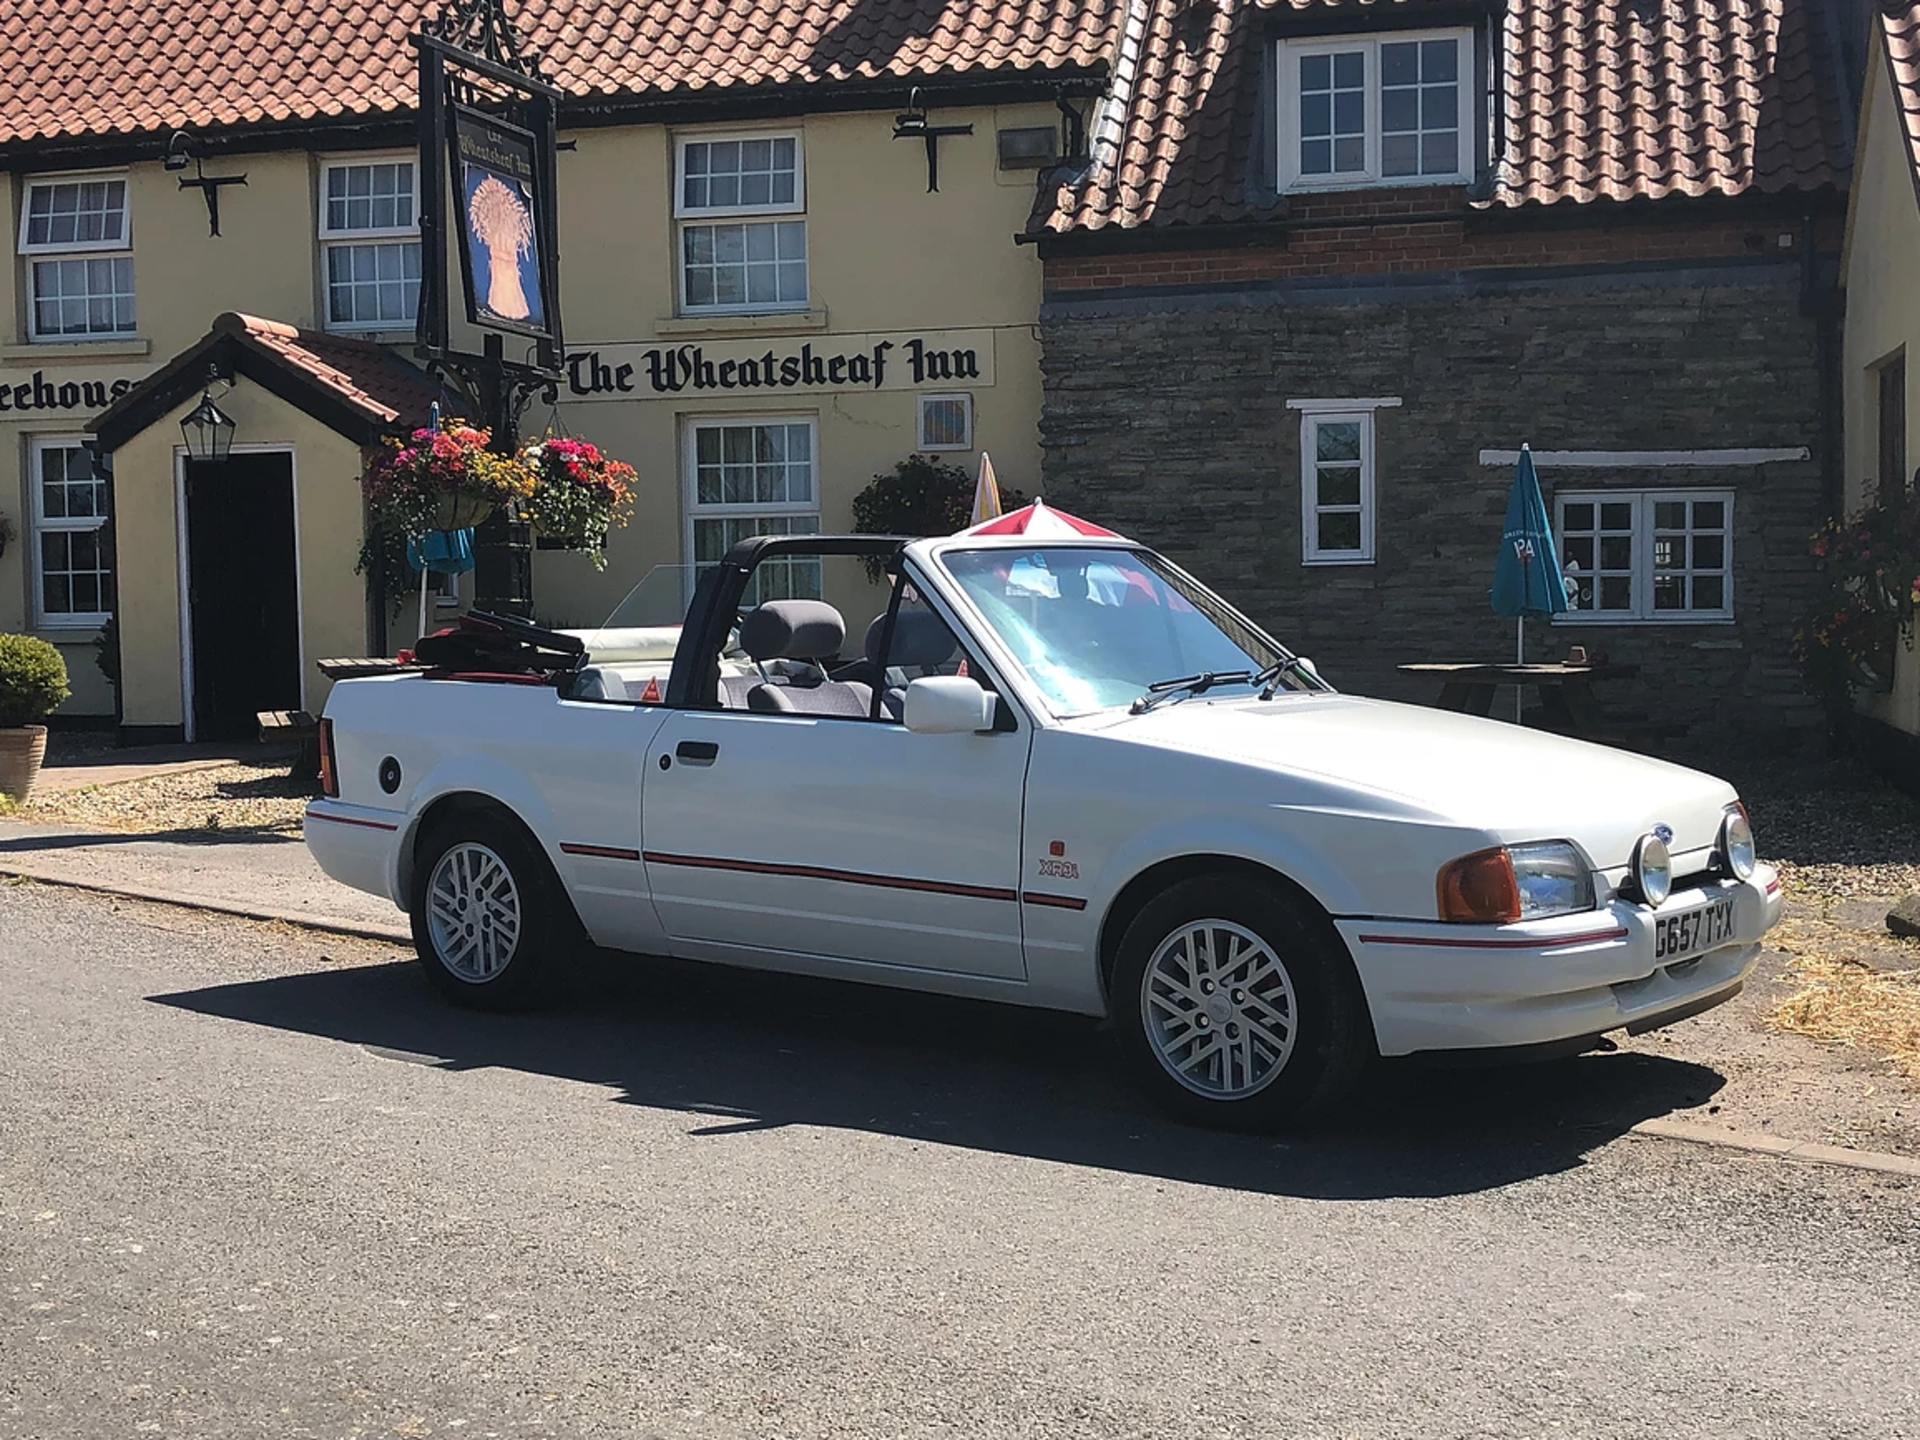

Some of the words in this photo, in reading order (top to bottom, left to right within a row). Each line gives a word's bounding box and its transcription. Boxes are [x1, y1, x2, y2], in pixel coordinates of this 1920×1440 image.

[565, 351, 635, 396] The
[641, 344, 894, 392] Wheatsheaf
[902, 339, 980, 383] Inn
[1513, 538, 1535, 559] IPA
[1655, 910, 1702, 958] G657
[1705, 900, 1734, 944] TYX
